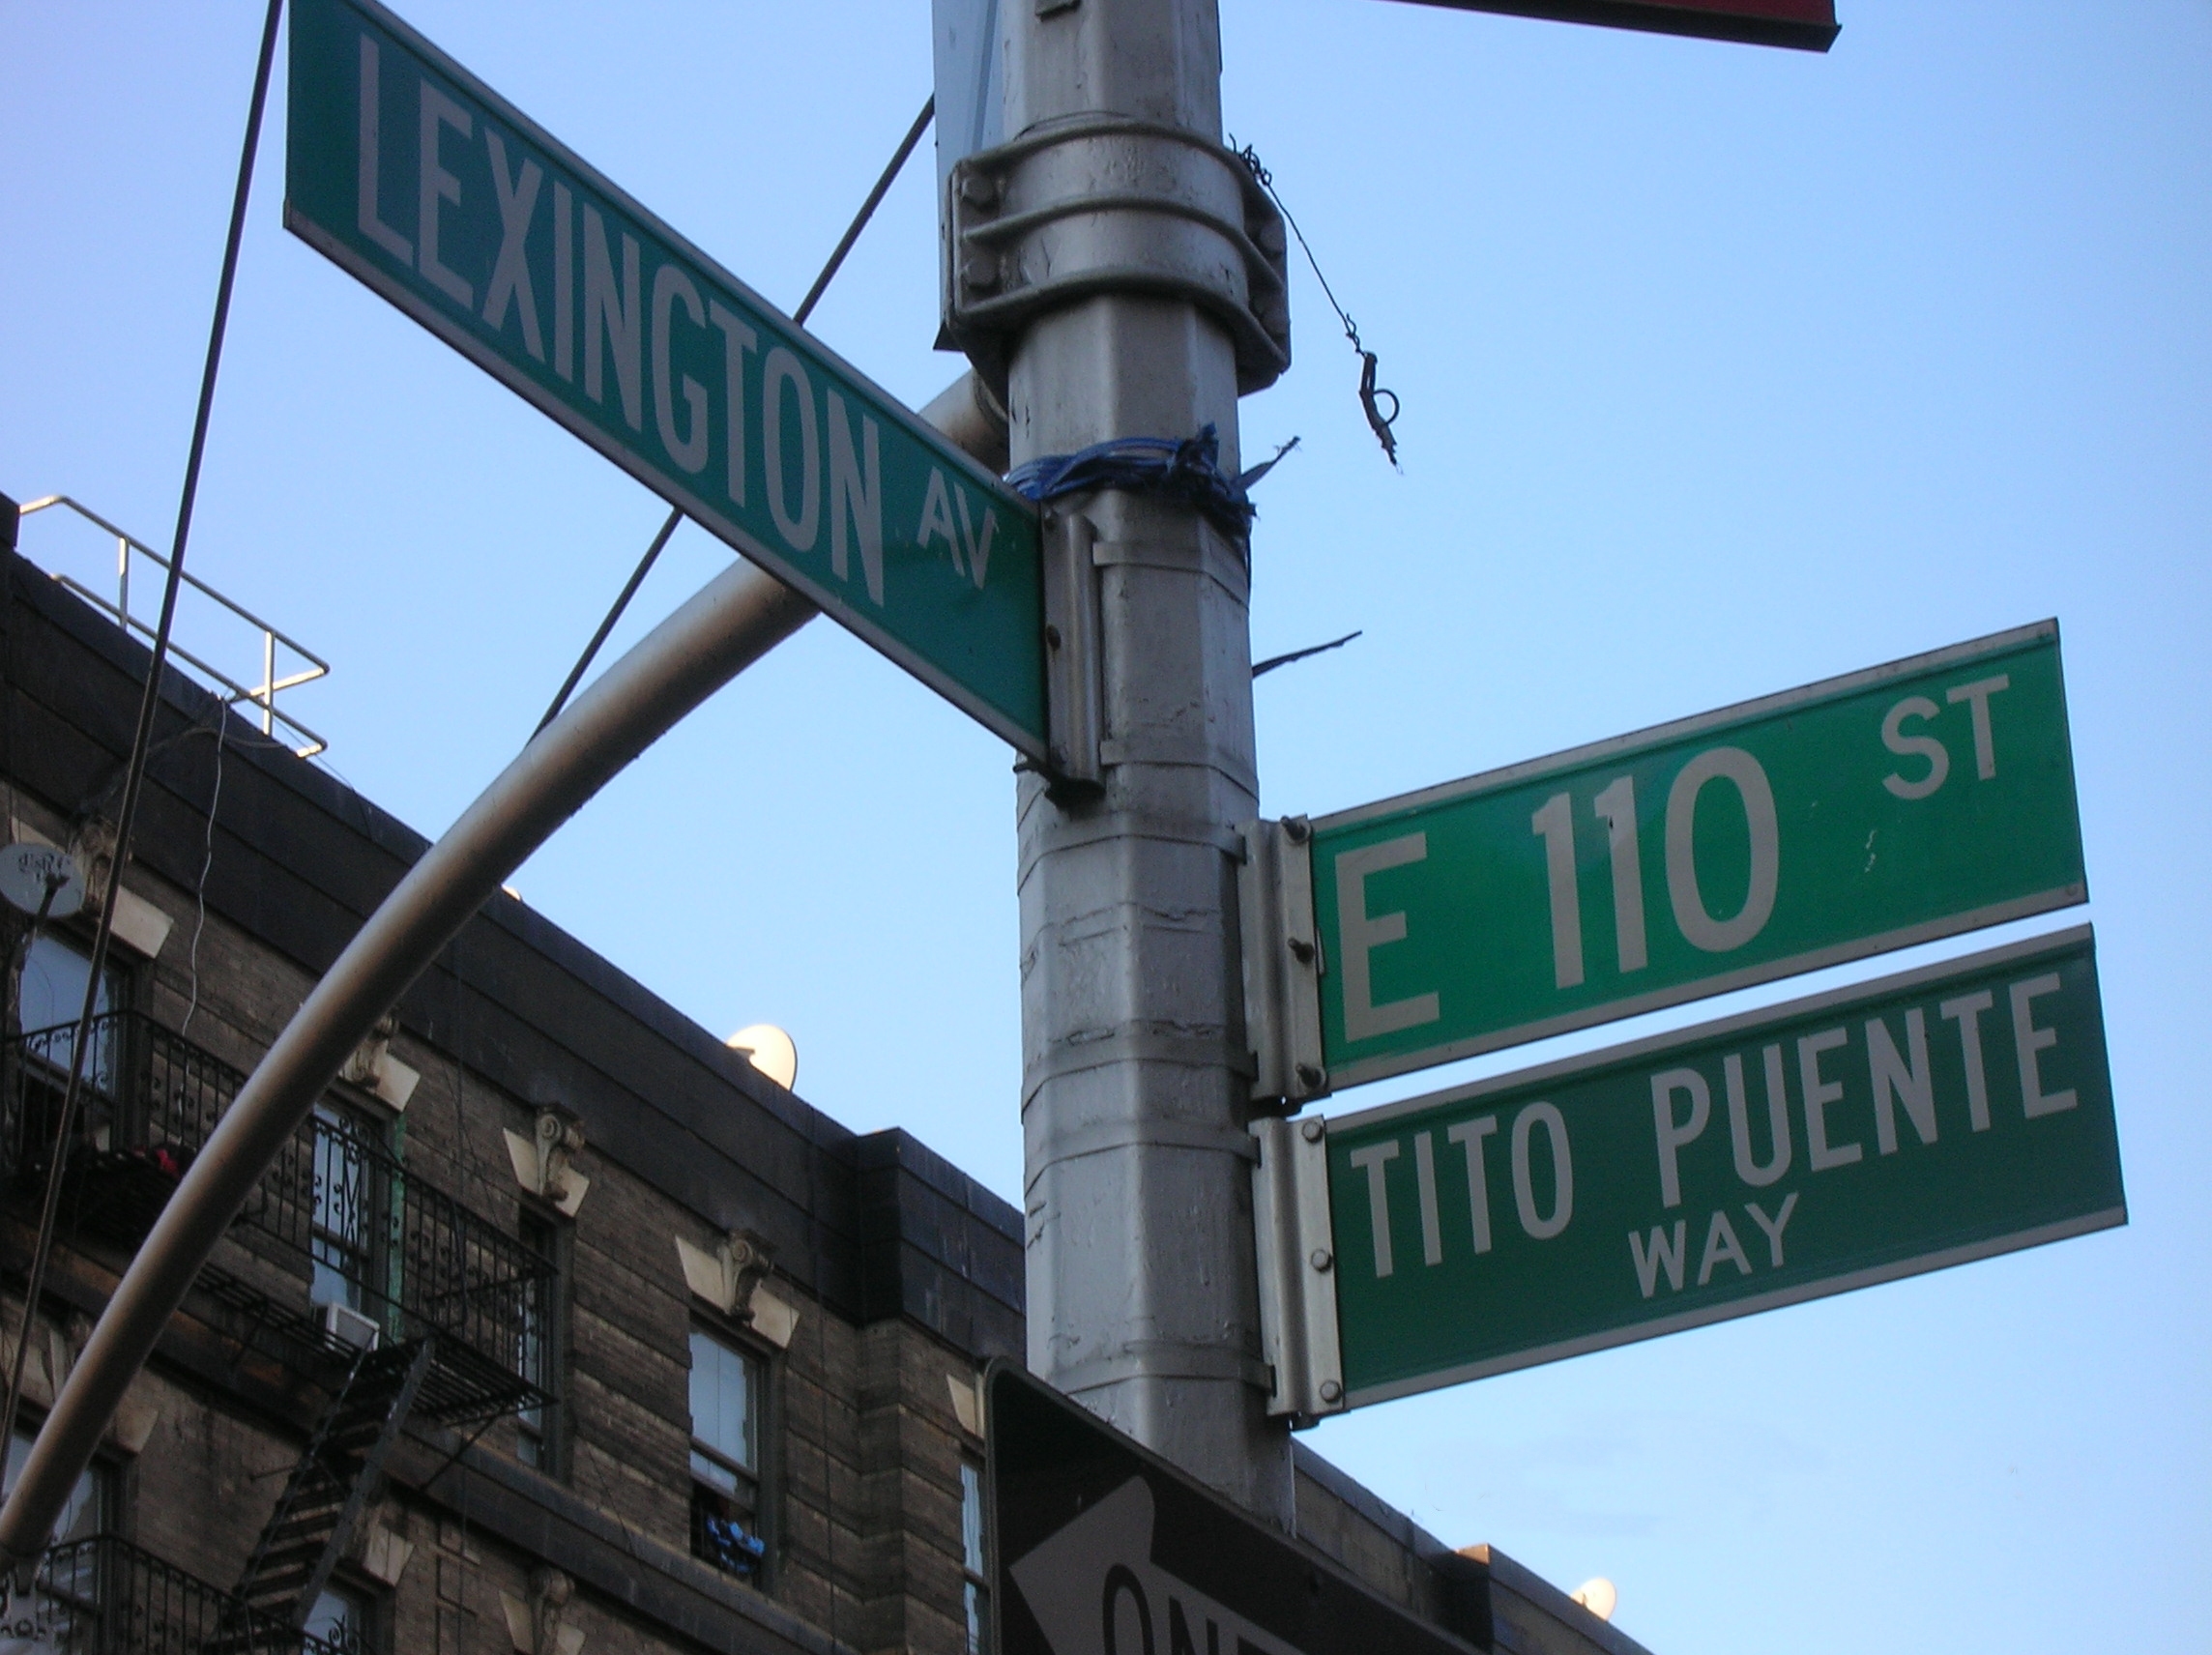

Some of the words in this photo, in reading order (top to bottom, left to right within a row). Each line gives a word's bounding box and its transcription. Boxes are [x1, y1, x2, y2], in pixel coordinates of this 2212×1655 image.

[357, 32, 885, 608] LEXINGTON
[917, 466, 998, 591] AV
[1334, 832, 1441, 1043] E
[1531, 745, 1780, 990] 110
[1879, 672, 2010, 801] ST
[1350, 1100, 1574, 1279] TITO
[1650, 972, 2079, 1209] PUENTE
[1628, 1192, 1799, 1300] WAY
